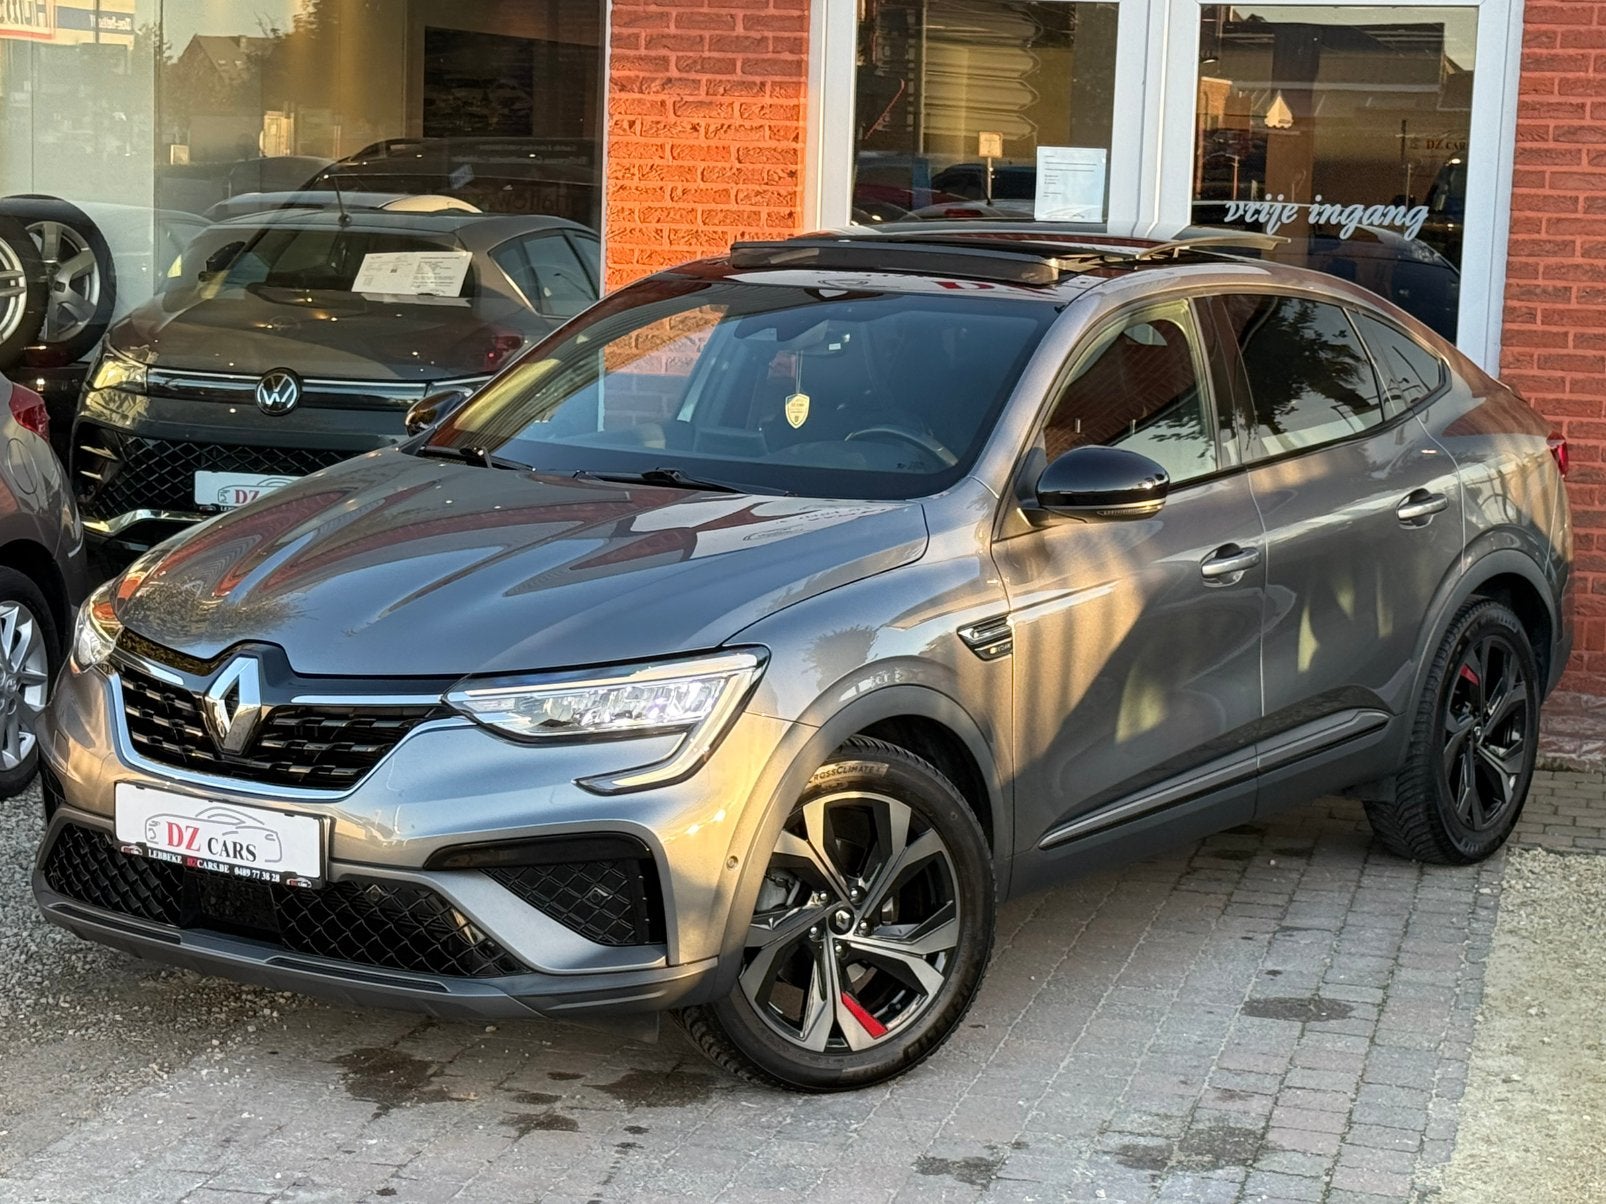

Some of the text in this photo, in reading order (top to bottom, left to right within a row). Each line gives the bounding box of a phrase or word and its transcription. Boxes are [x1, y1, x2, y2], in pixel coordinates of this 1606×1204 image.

[1224, 193, 1430, 241] vrije ingang
[166, 821, 257, 862] DZ CARS
